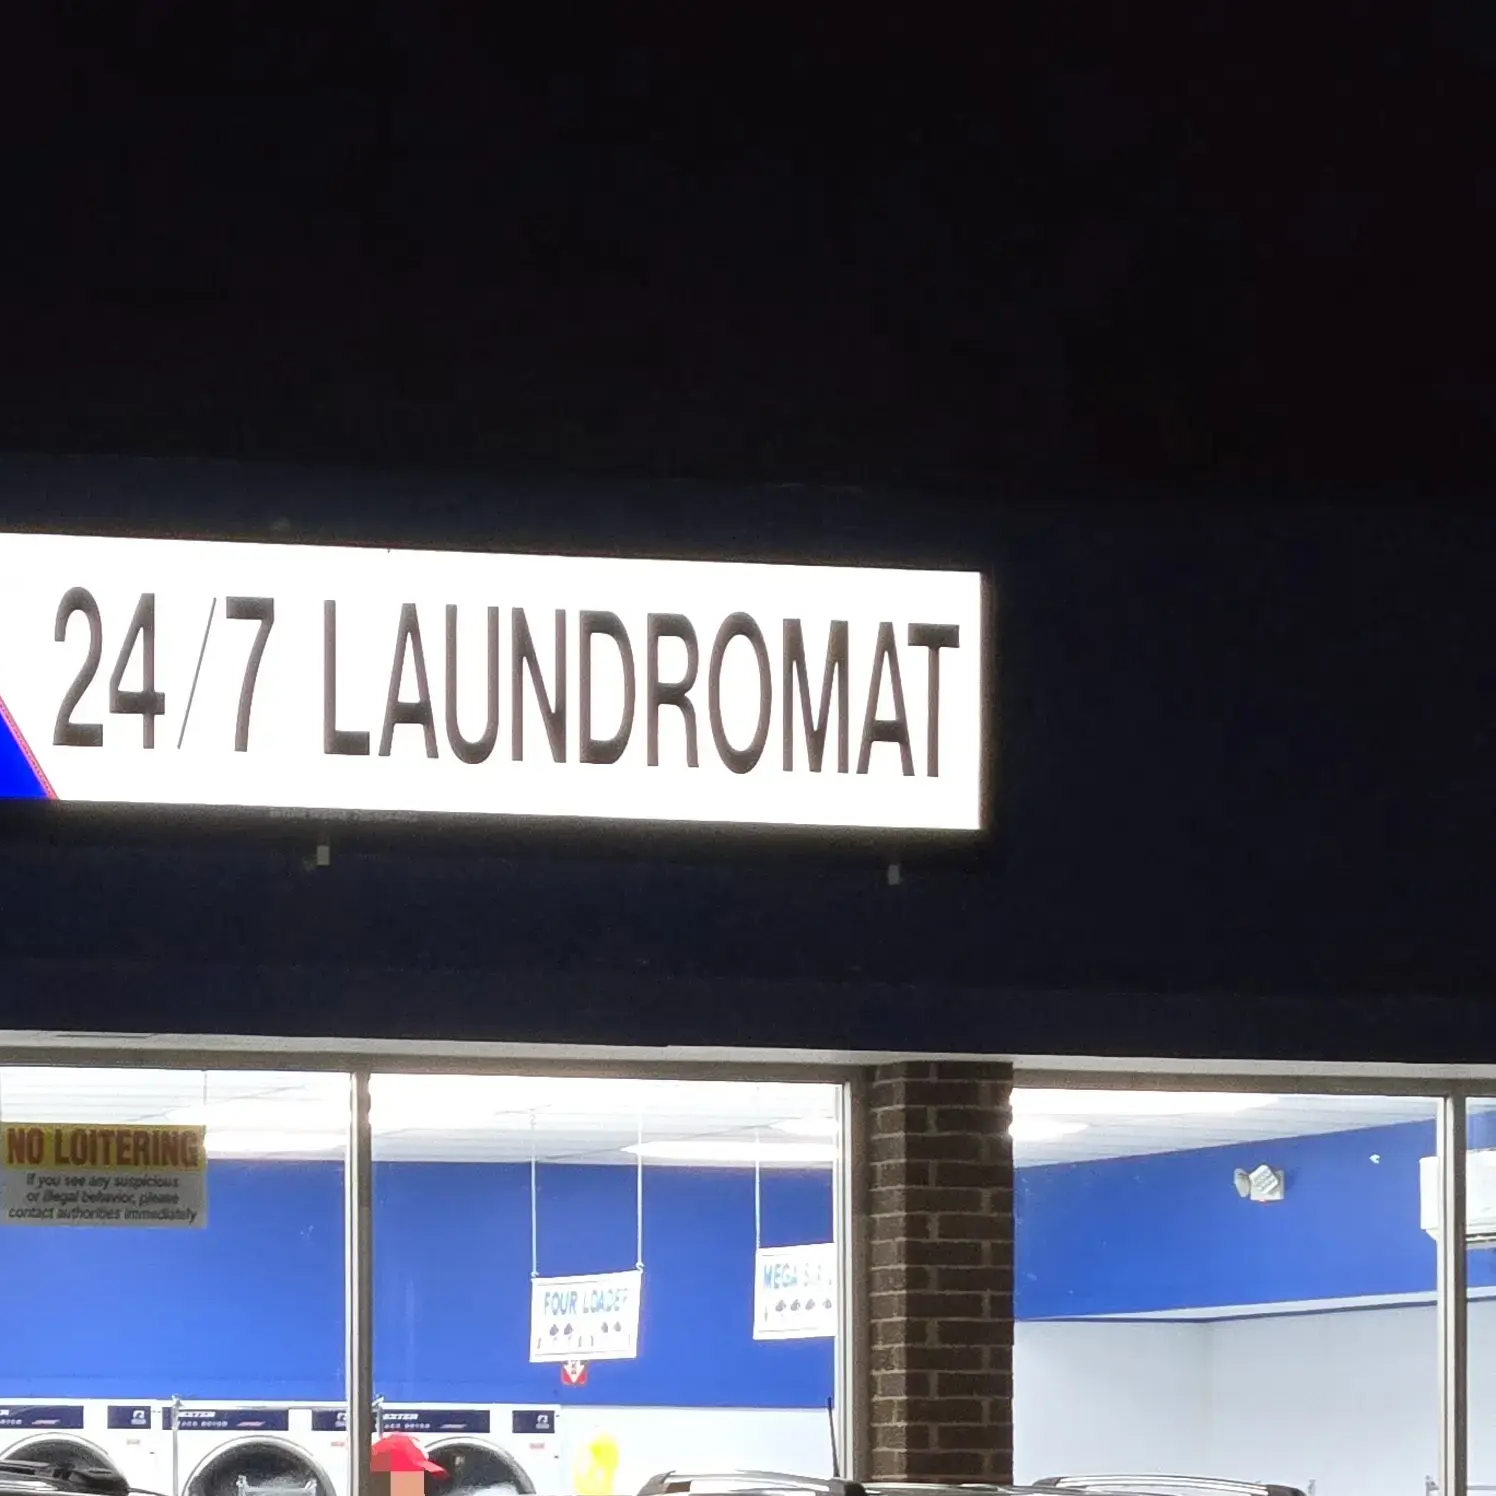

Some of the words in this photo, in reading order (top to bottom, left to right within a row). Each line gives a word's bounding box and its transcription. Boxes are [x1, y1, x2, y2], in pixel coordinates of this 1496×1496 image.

[52, 586, 276, 752] 24/7
[322, 599, 961, 778] LAUNDROMAT
[7, 1128, 45, 1165] NO
[54, 1129, 199, 1168] LOITERING
[38, 1176, 61, 1189] you
[64, 1177, 86, 1187] see
[88, 1176, 110, 1190] any
[114, 1174, 179, 1188] suspicious
[27, 1192, 38, 1202] or
[139, 1191, 180, 1207] please
[8, 1207, 54, 1219] contact
[124, 1207, 198, 1225] immediately
[543, 1290, 577, 1316] FOUR
